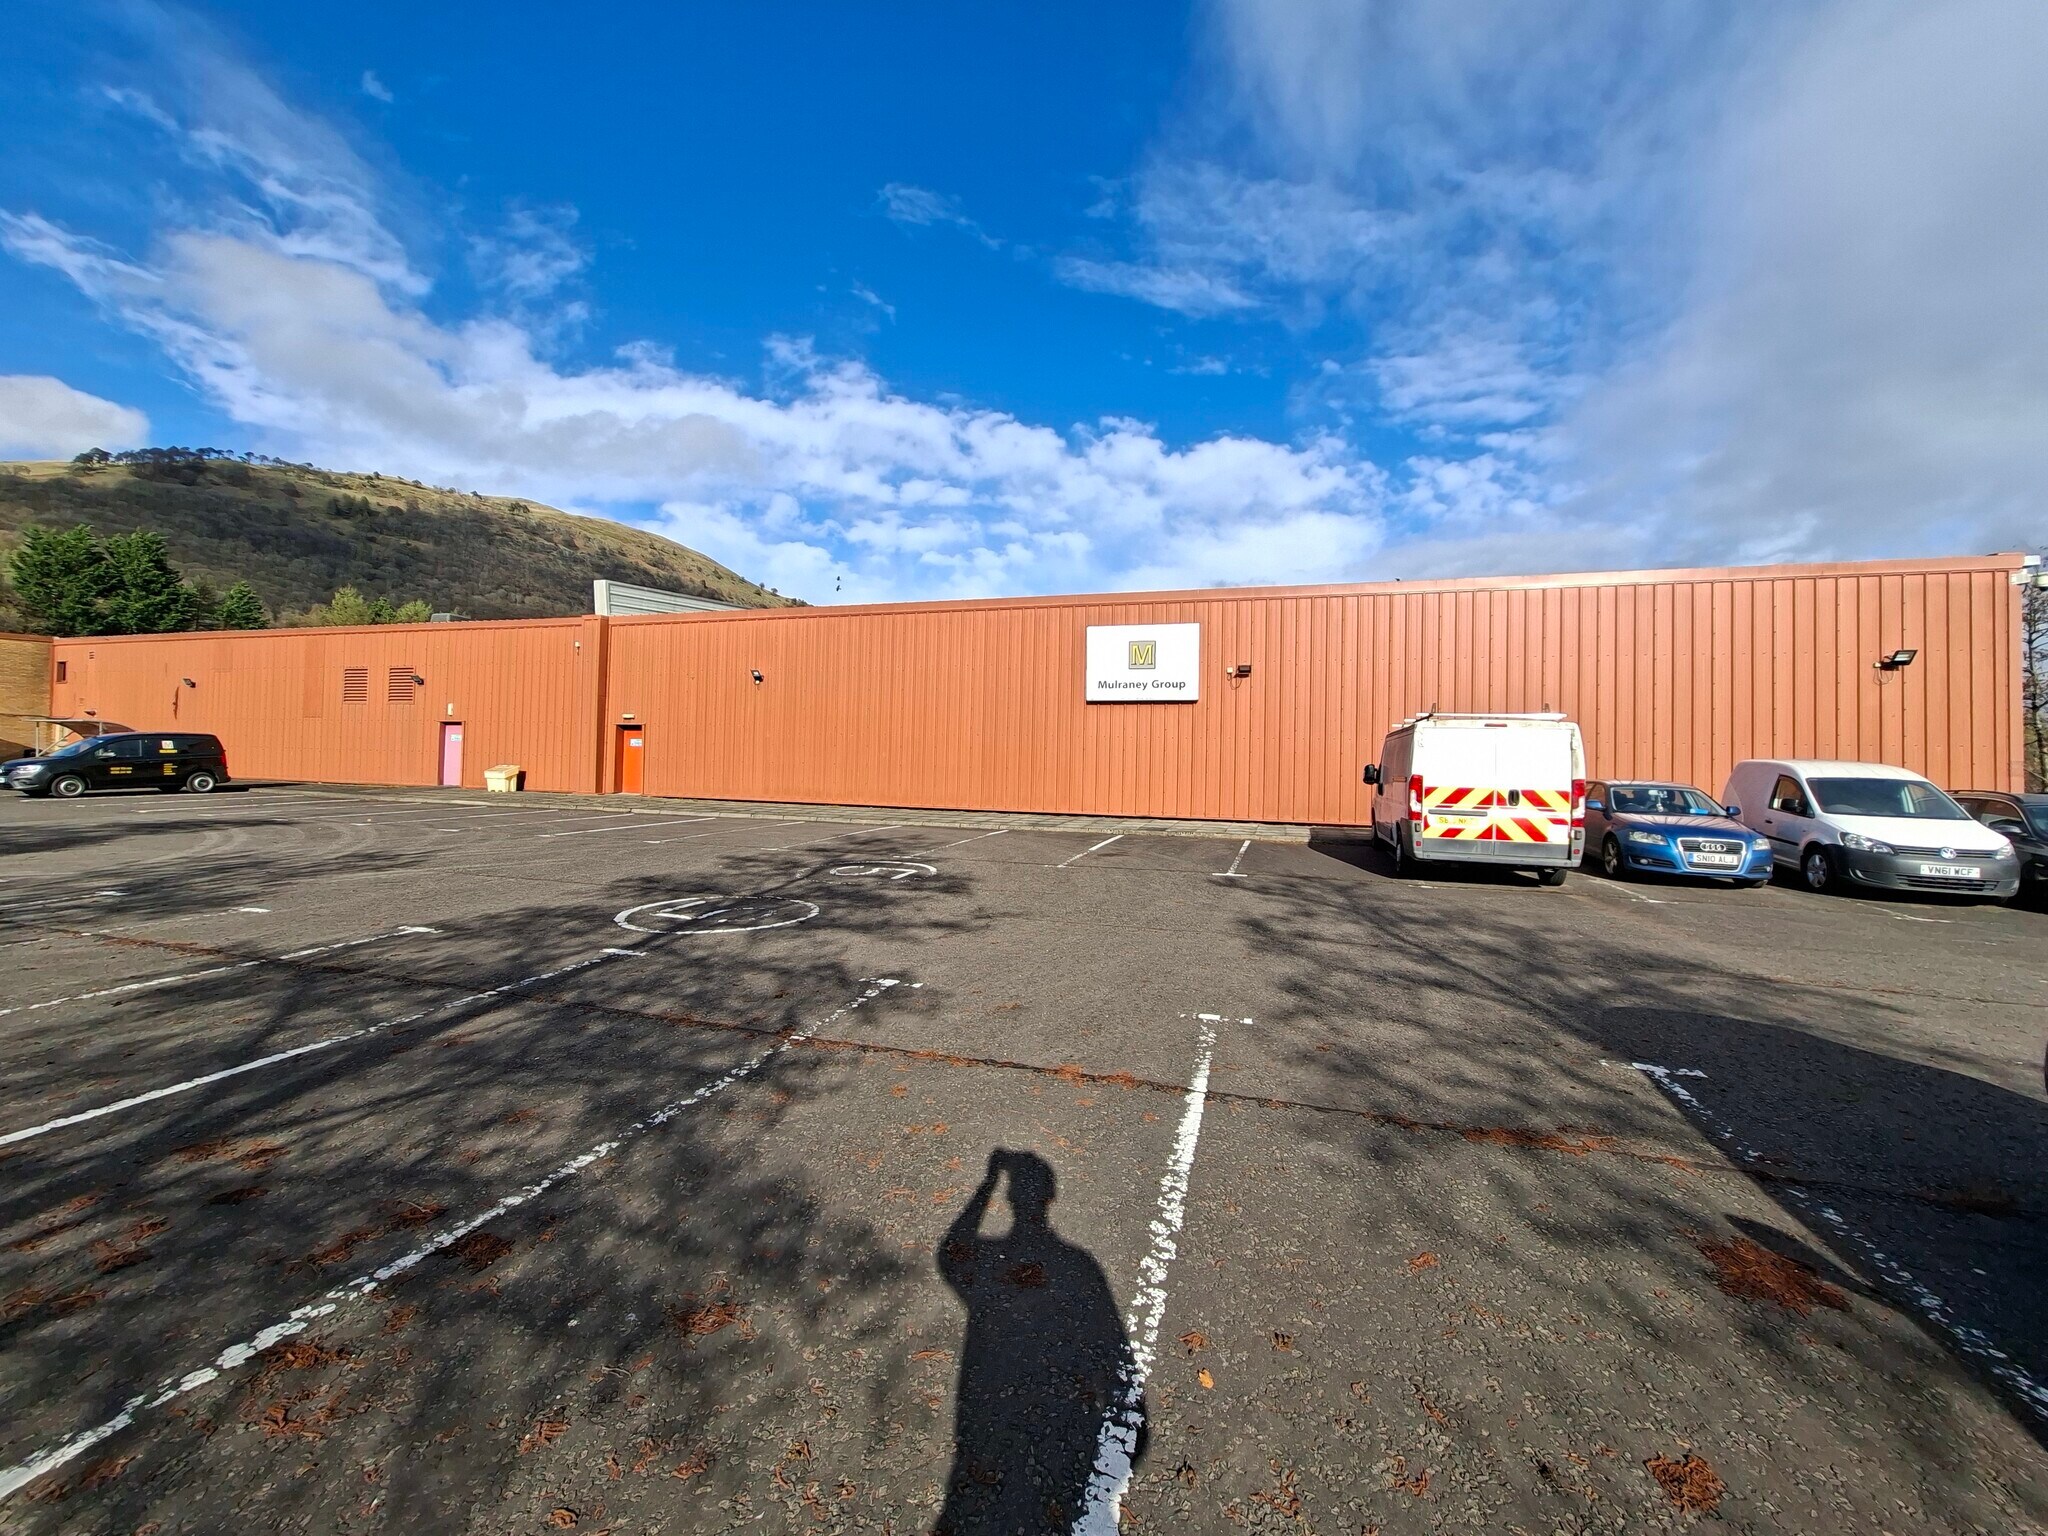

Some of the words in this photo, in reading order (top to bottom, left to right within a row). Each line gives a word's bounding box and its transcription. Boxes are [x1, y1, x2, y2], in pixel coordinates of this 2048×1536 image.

[1130, 643, 1154, 666] M
[1097, 680, 1148, 691] Mulraney
[1151, 679, 1186, 690] Group
[1927, 866, 1951, 875] VN61
[1953, 867, 1974, 876] WCF
